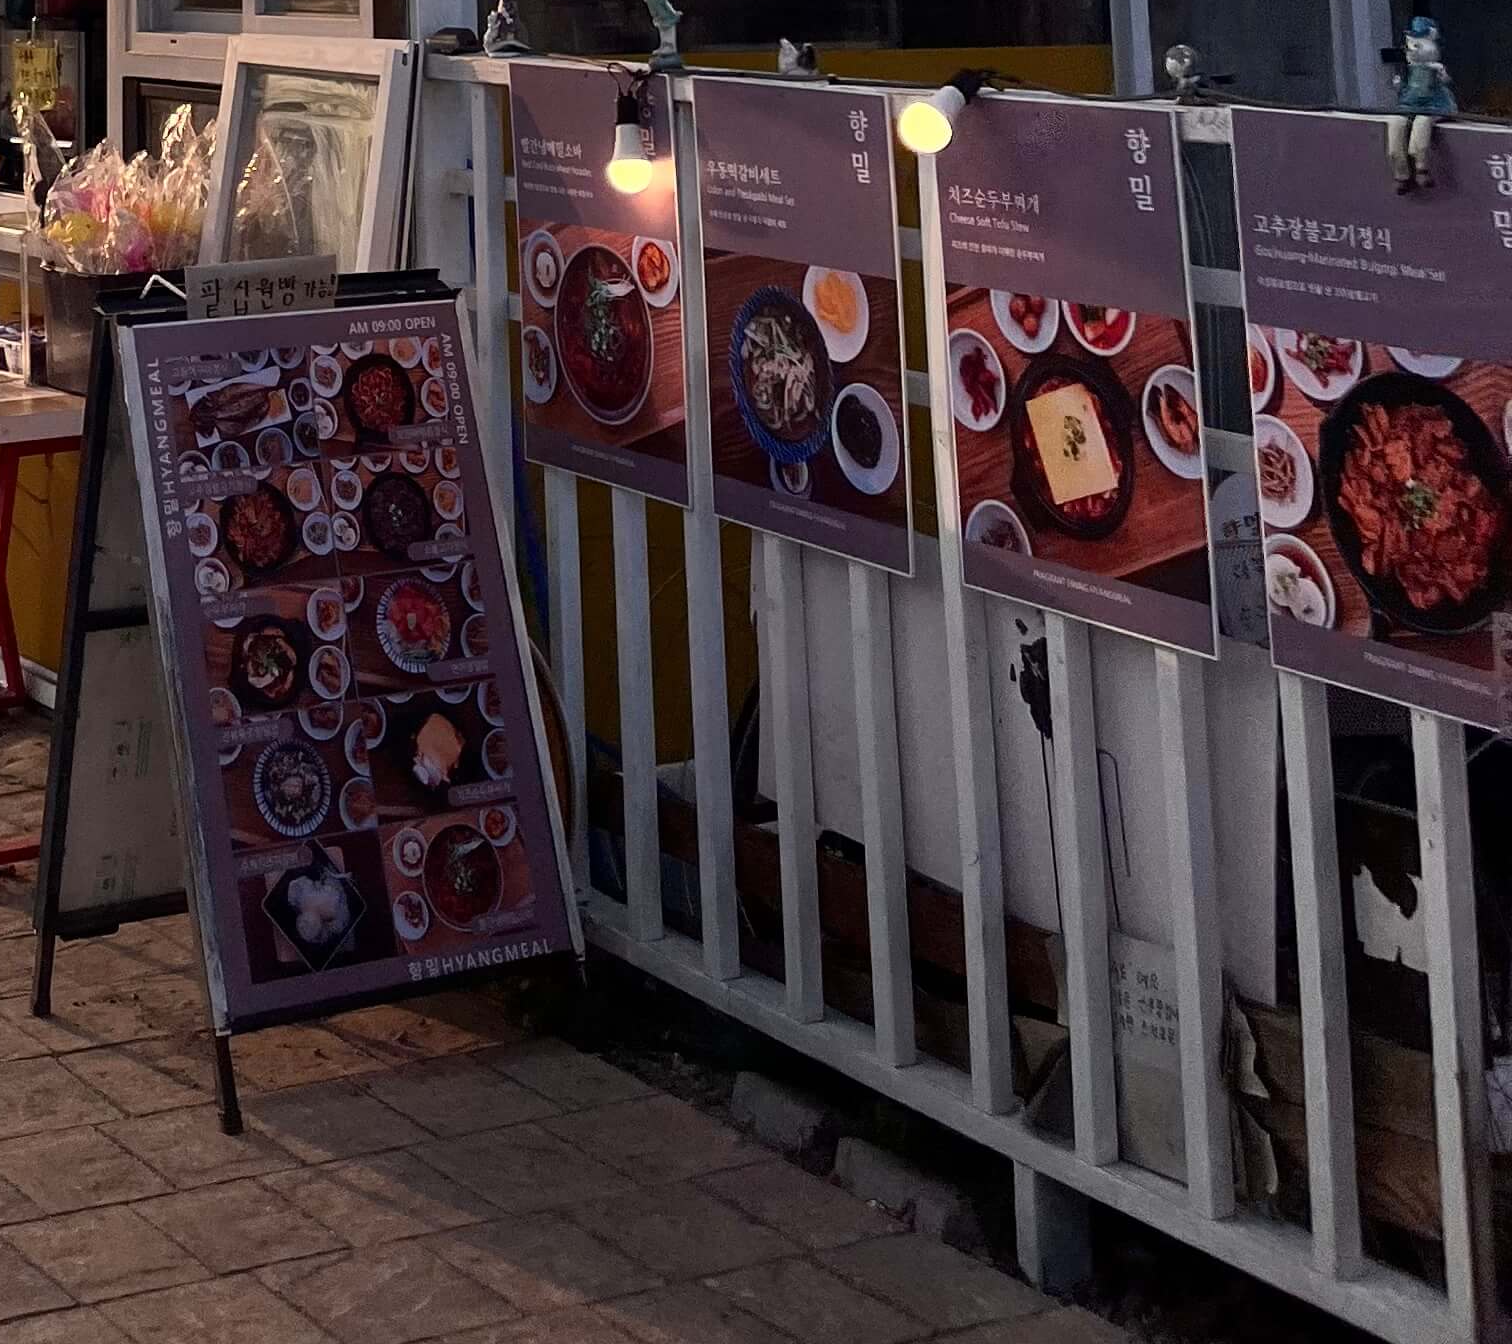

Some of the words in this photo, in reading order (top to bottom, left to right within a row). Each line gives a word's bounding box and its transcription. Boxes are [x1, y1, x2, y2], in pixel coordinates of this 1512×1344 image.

[848, 109, 872, 185] 향밀
[706, 160, 782, 185] 우동떡갈비세트
[1124, 127, 1155, 213] 향밀
[948, 184, 1040, 215] 치즈순두부찌개
[1252, 213, 1392, 254] 고추장불고기정식
[200, 277, 223, 318] 팥
[349, 319, 369, 335] AM
[371, 317, 402, 333] 09:00
[405, 316, 437, 330] OPEN
[440, 332, 454, 358] AM
[445, 362, 461, 400] 09:00
[453, 403, 469, 446] OPEN
